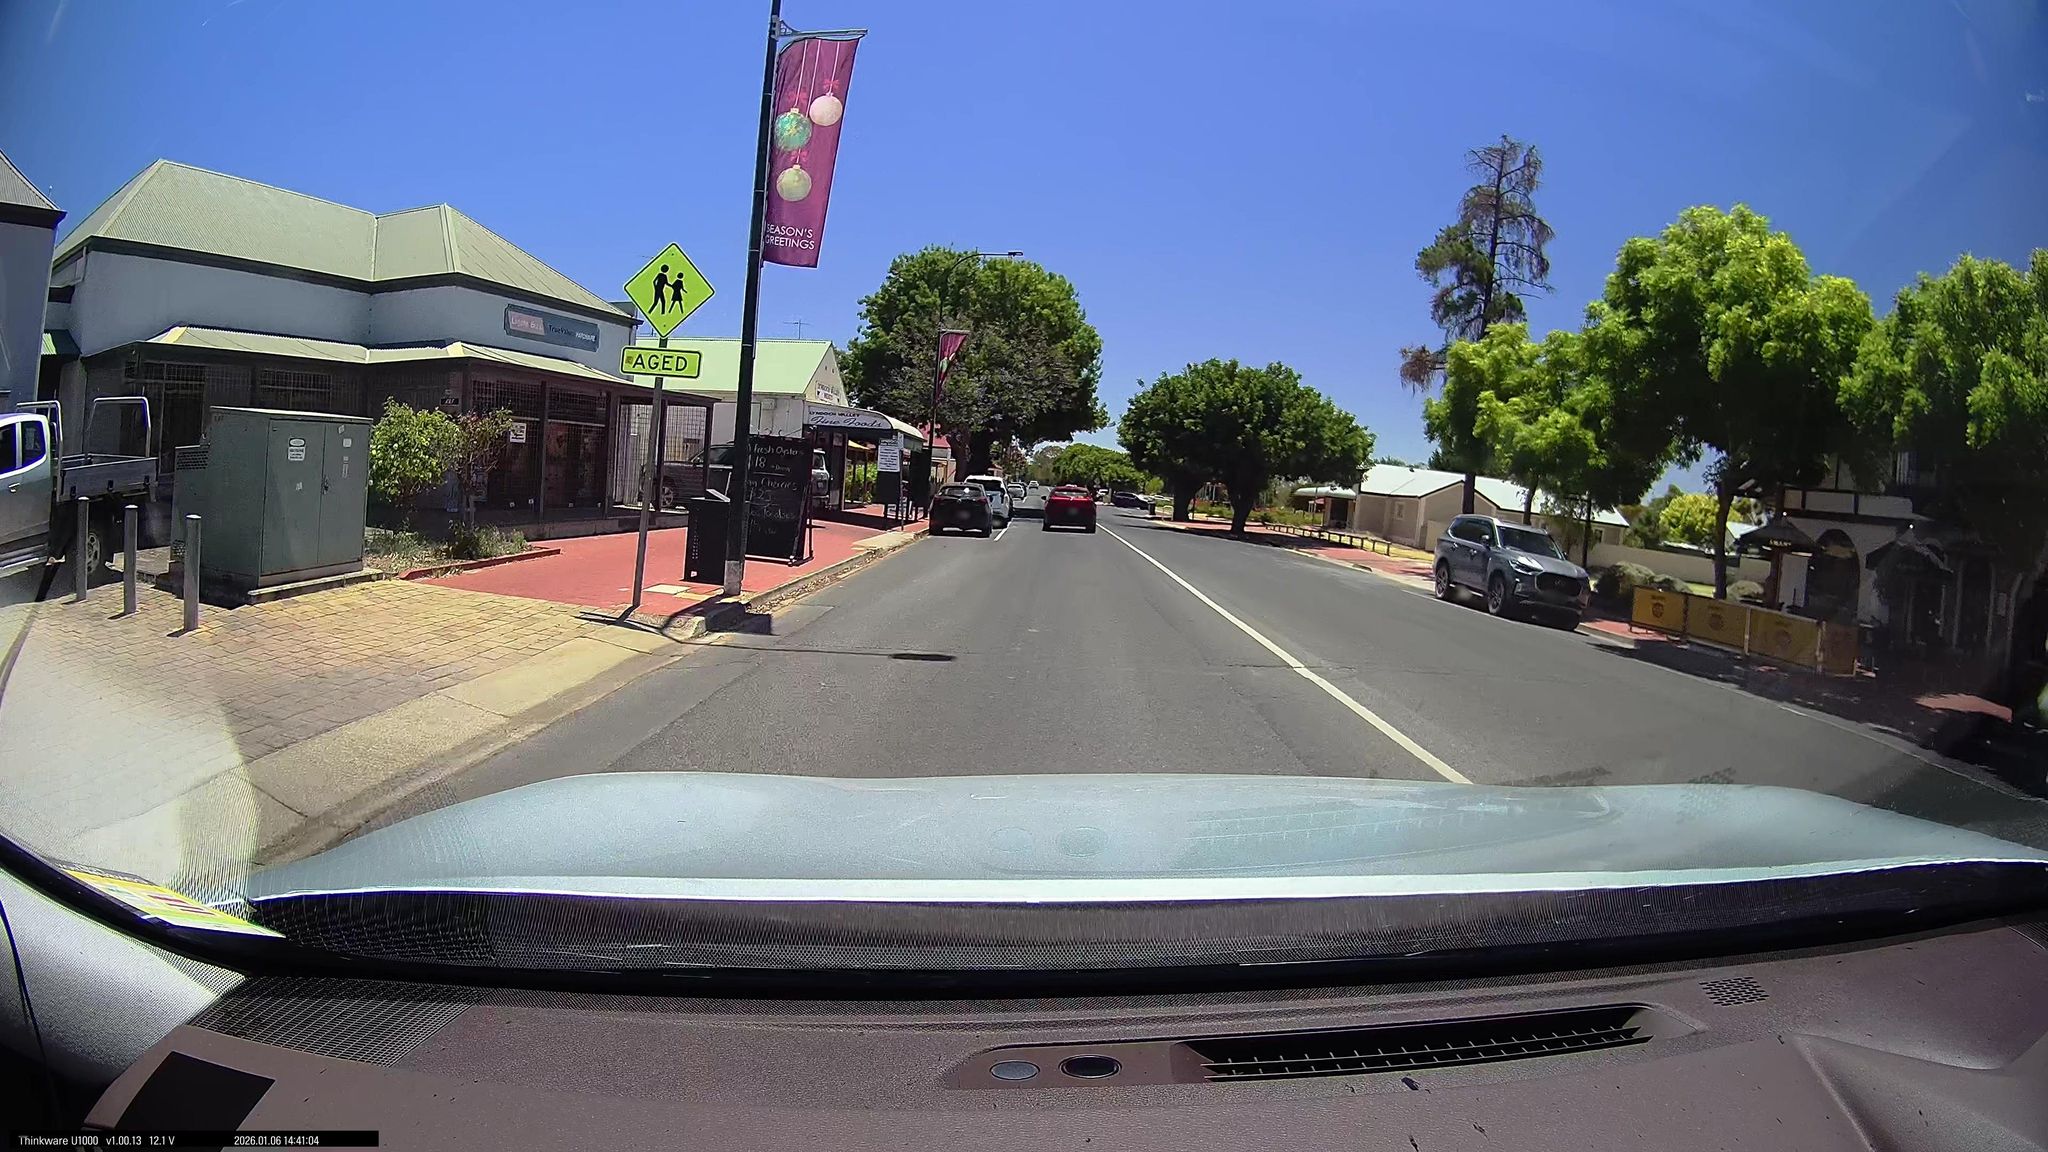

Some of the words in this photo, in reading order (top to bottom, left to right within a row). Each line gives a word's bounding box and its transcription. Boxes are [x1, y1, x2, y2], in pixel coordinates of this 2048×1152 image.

[766, 223, 813, 239] SEASON'S
[765, 234, 815, 250] GREETINGS
[632, 353, 688, 371] AGED
[810, 415, 840, 425] Fine
[843, 417, 882, 428] Foods
